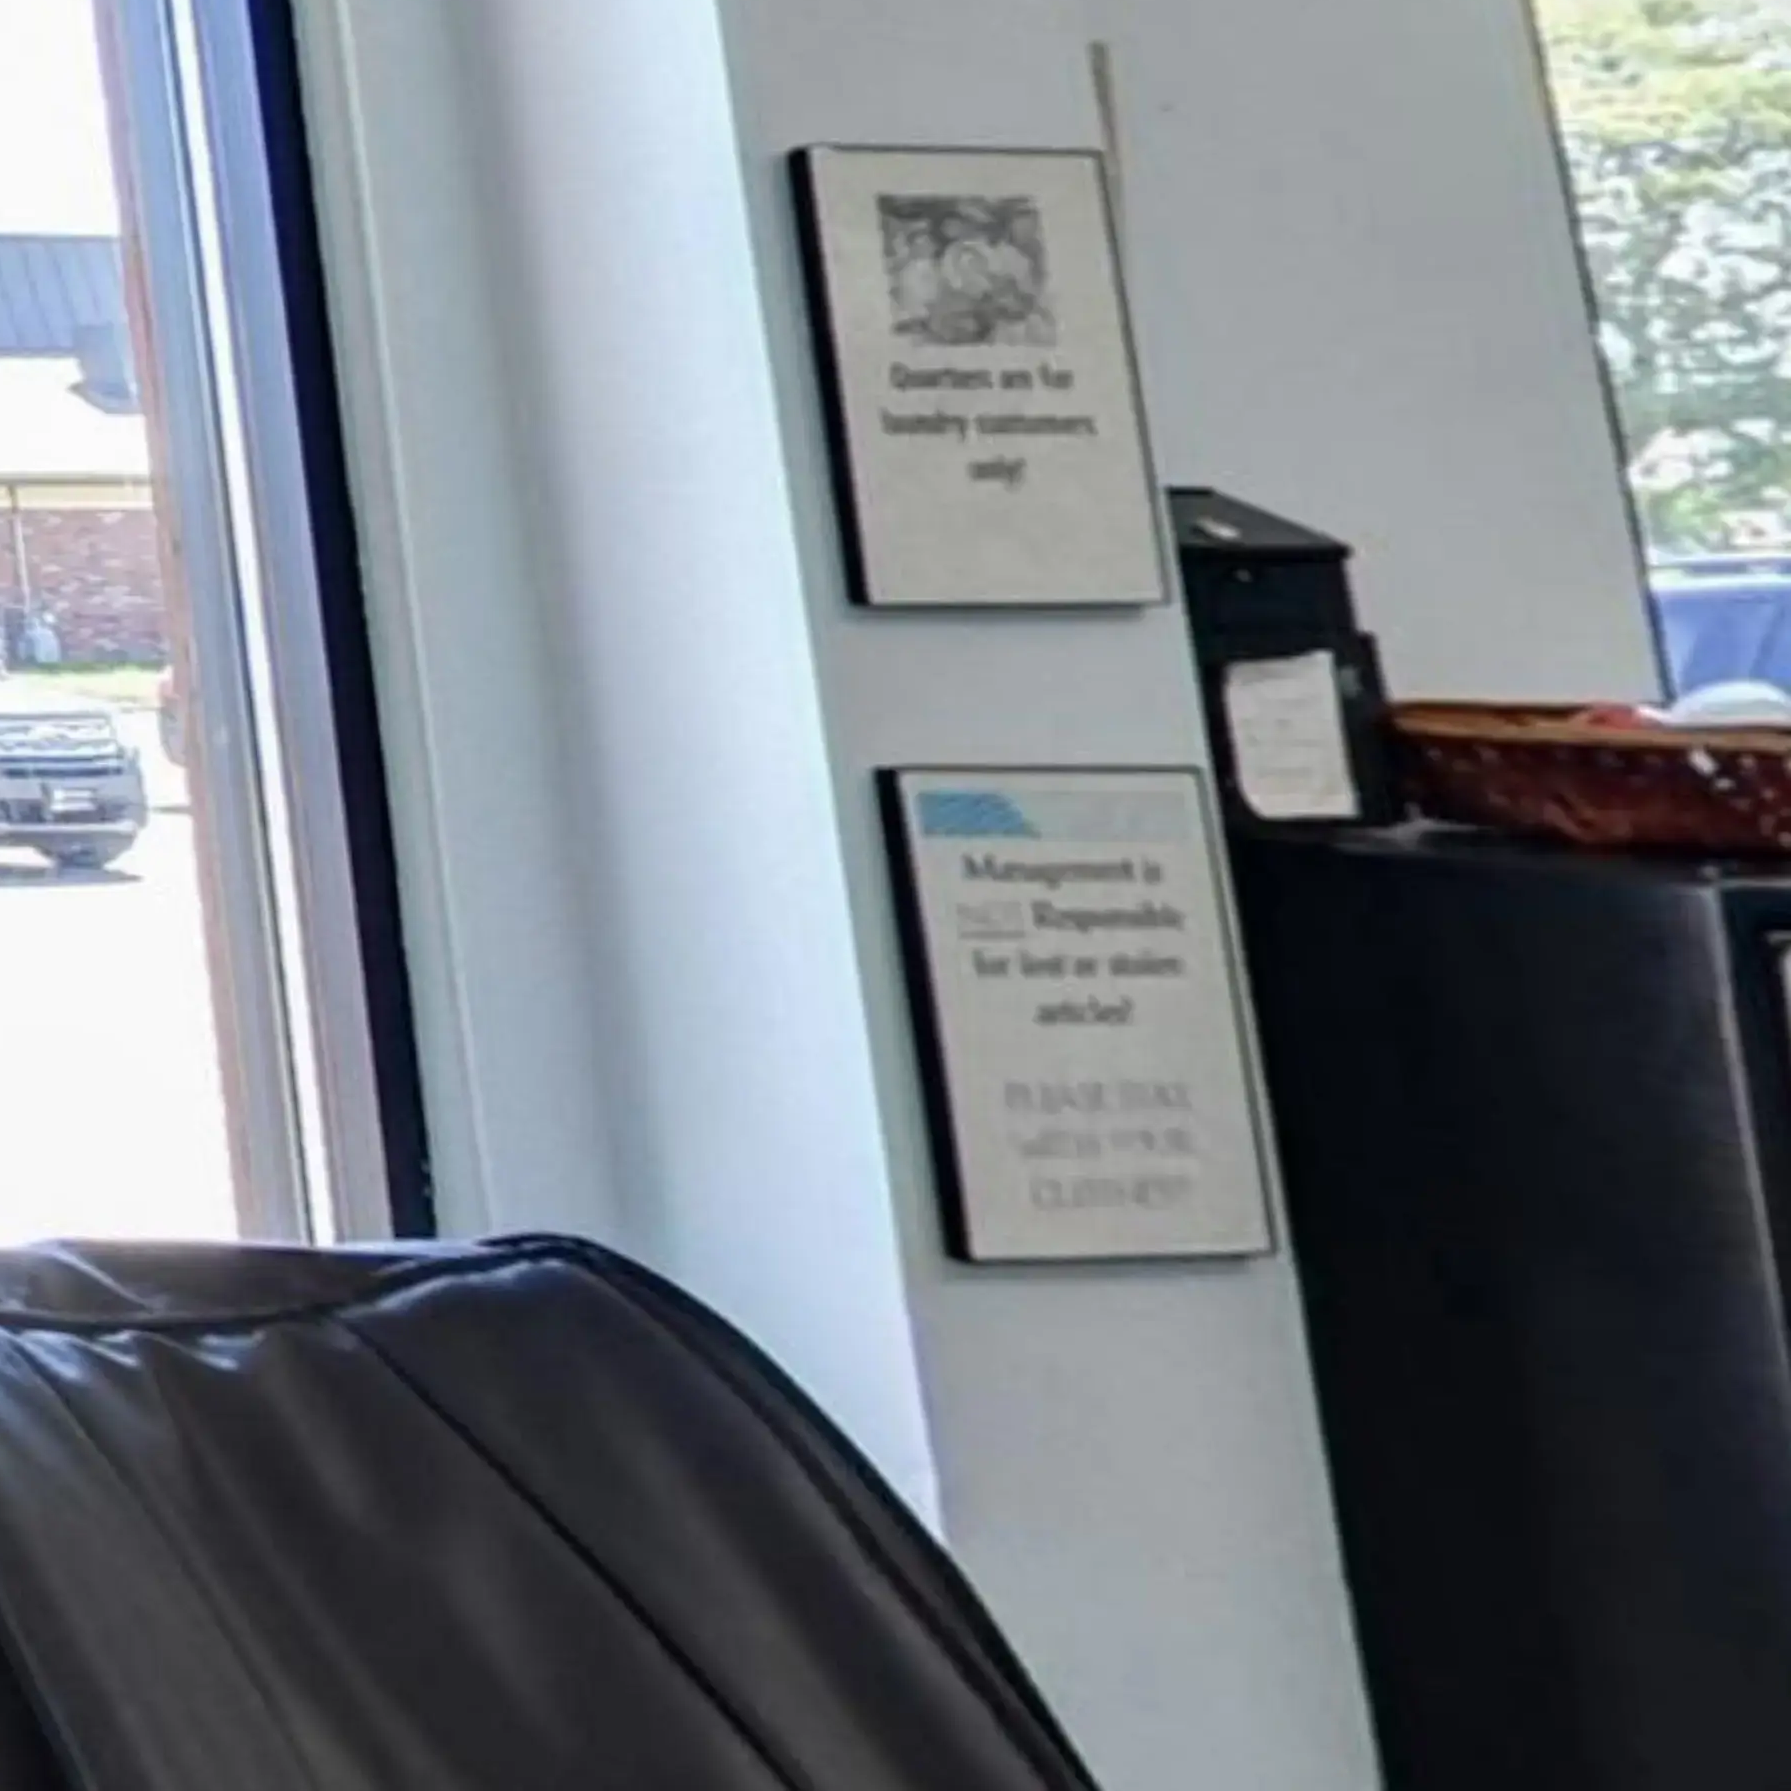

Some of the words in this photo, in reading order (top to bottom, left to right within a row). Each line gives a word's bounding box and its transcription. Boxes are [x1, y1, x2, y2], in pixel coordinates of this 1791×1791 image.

[889, 362, 994, 391] Quarters
[1000, 370, 1034, 391] are
[1039, 361, 1074, 391] for
[880, 408, 969, 443] laundry
[974, 413, 1100, 437] customers
[961, 852, 1135, 891] Management
[1141, 854, 1164, 884] is
[1029, 899, 1185, 934] Responsible
[972, 949, 1011, 979] for
[1019, 950, 1067, 979] lost
[1073, 956, 1099, 978] or
[1107, 950, 1185, 978] stolen
